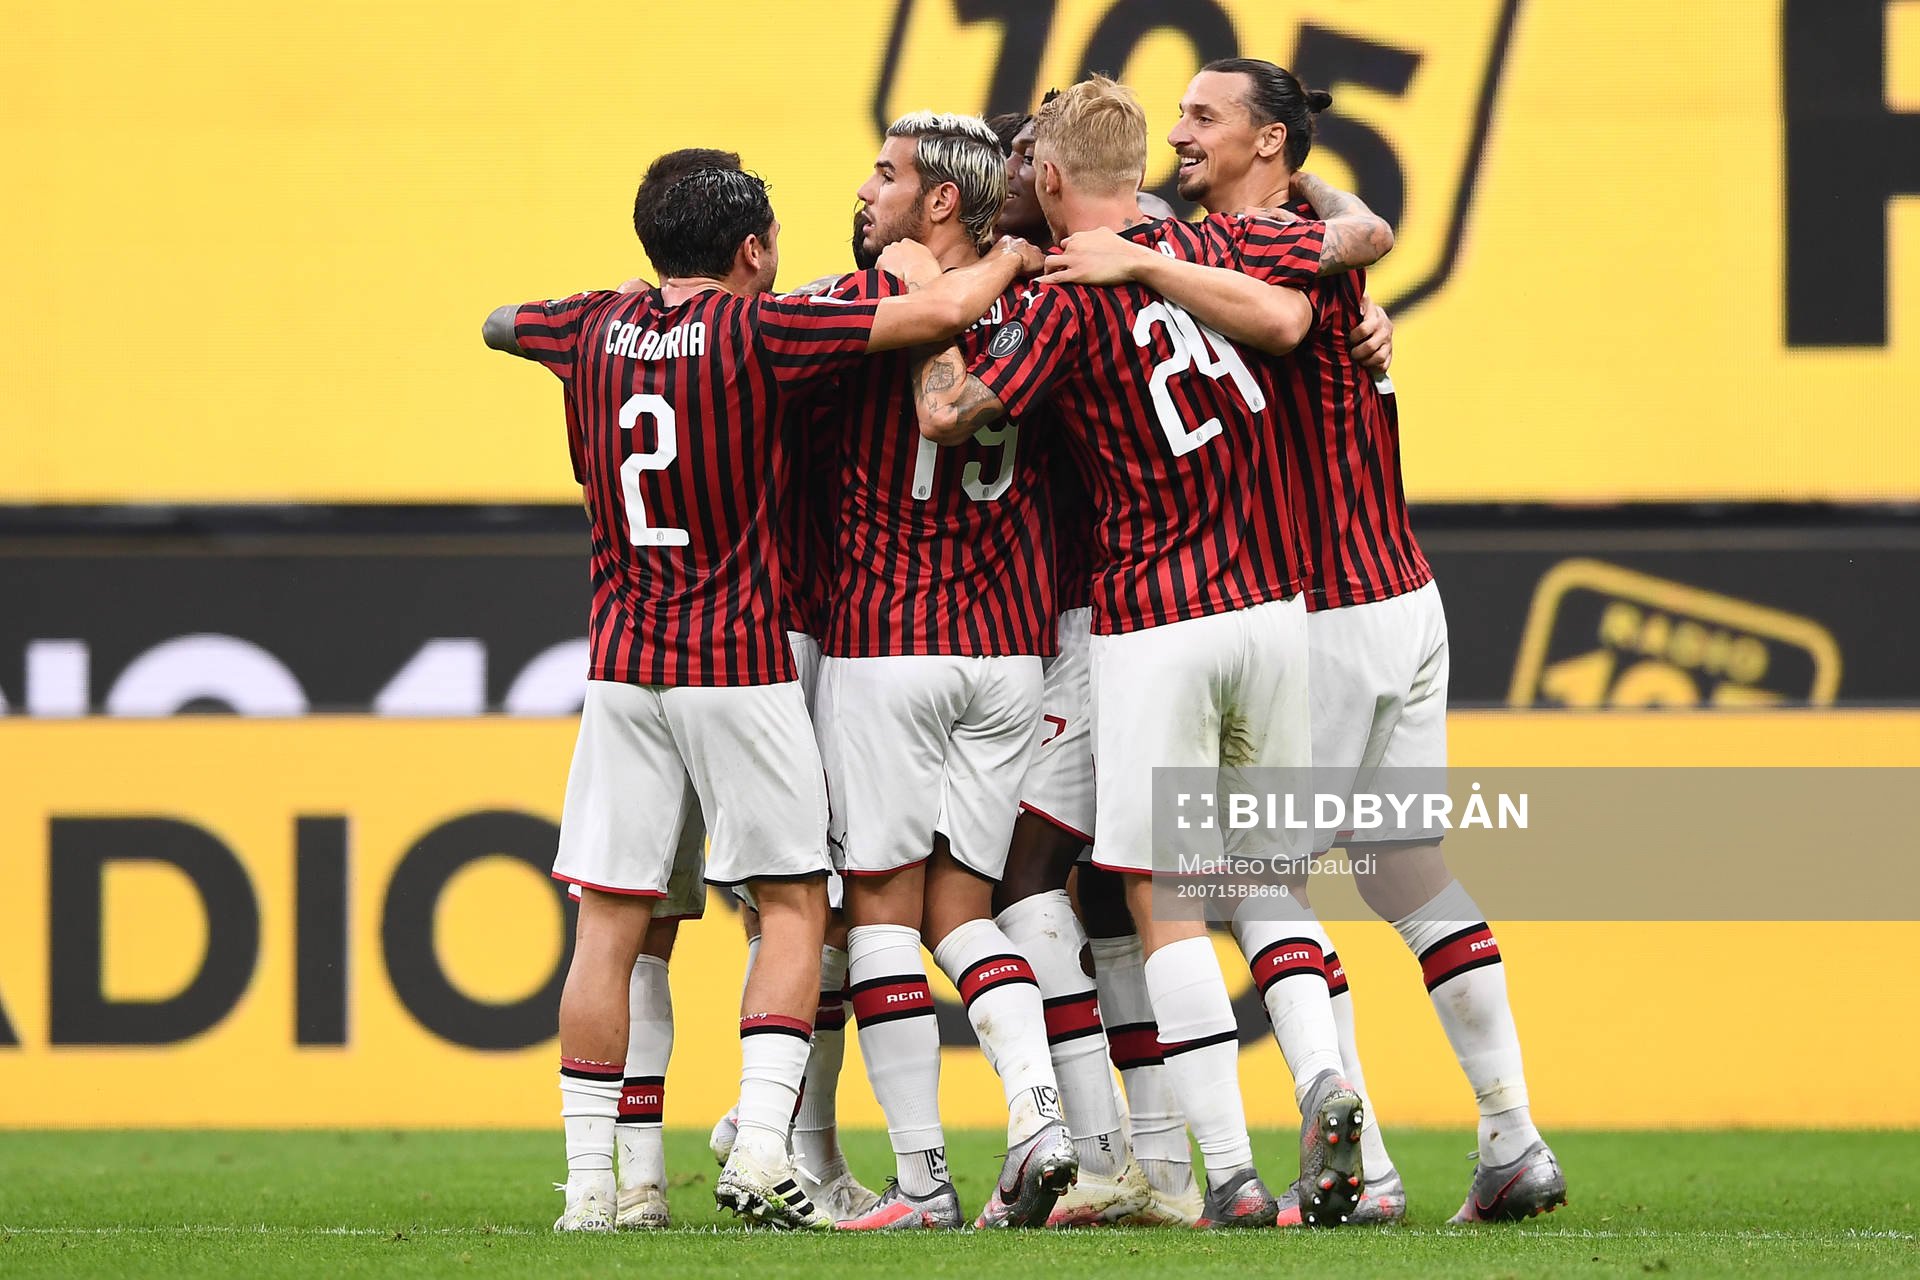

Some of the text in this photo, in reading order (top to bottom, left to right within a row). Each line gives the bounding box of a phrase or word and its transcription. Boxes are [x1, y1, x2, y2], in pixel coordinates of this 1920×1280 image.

[605, 320, 706, 361] CALABRIA
[1132, 300, 1267, 457] 24
[618, 393, 690, 546] 2
[0, 808, 573, 1054] DIO
[978, 964, 1019, 981] ACM
[1273, 950, 1310, 966] ACM
[886, 990, 924, 1004] ACM
[627, 1095, 658, 1105] ACM
